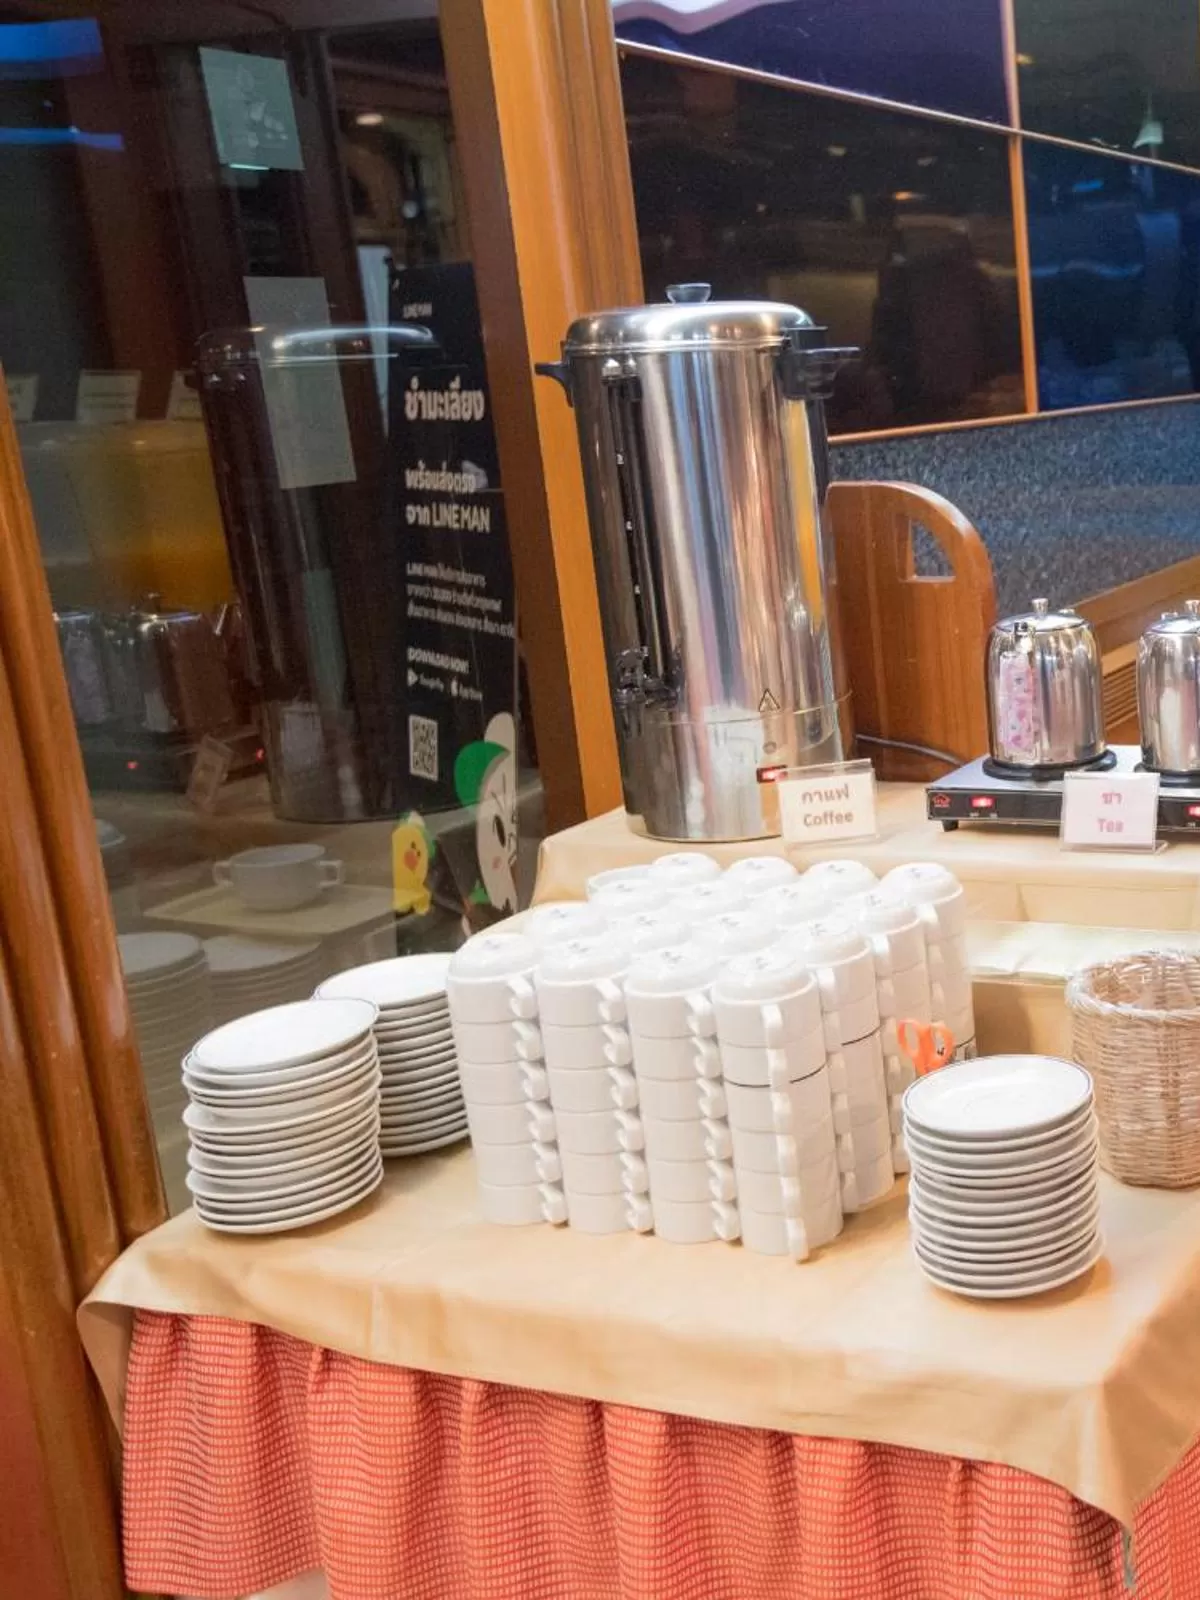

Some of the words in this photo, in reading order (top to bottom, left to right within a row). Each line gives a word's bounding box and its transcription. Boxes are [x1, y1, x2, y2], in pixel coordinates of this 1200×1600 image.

[432, 501, 460, 530] LINE
[460, 504, 491, 533] MAN
[801, 782, 850, 804] กาแฟ
[803, 810, 854, 828] Coffee
